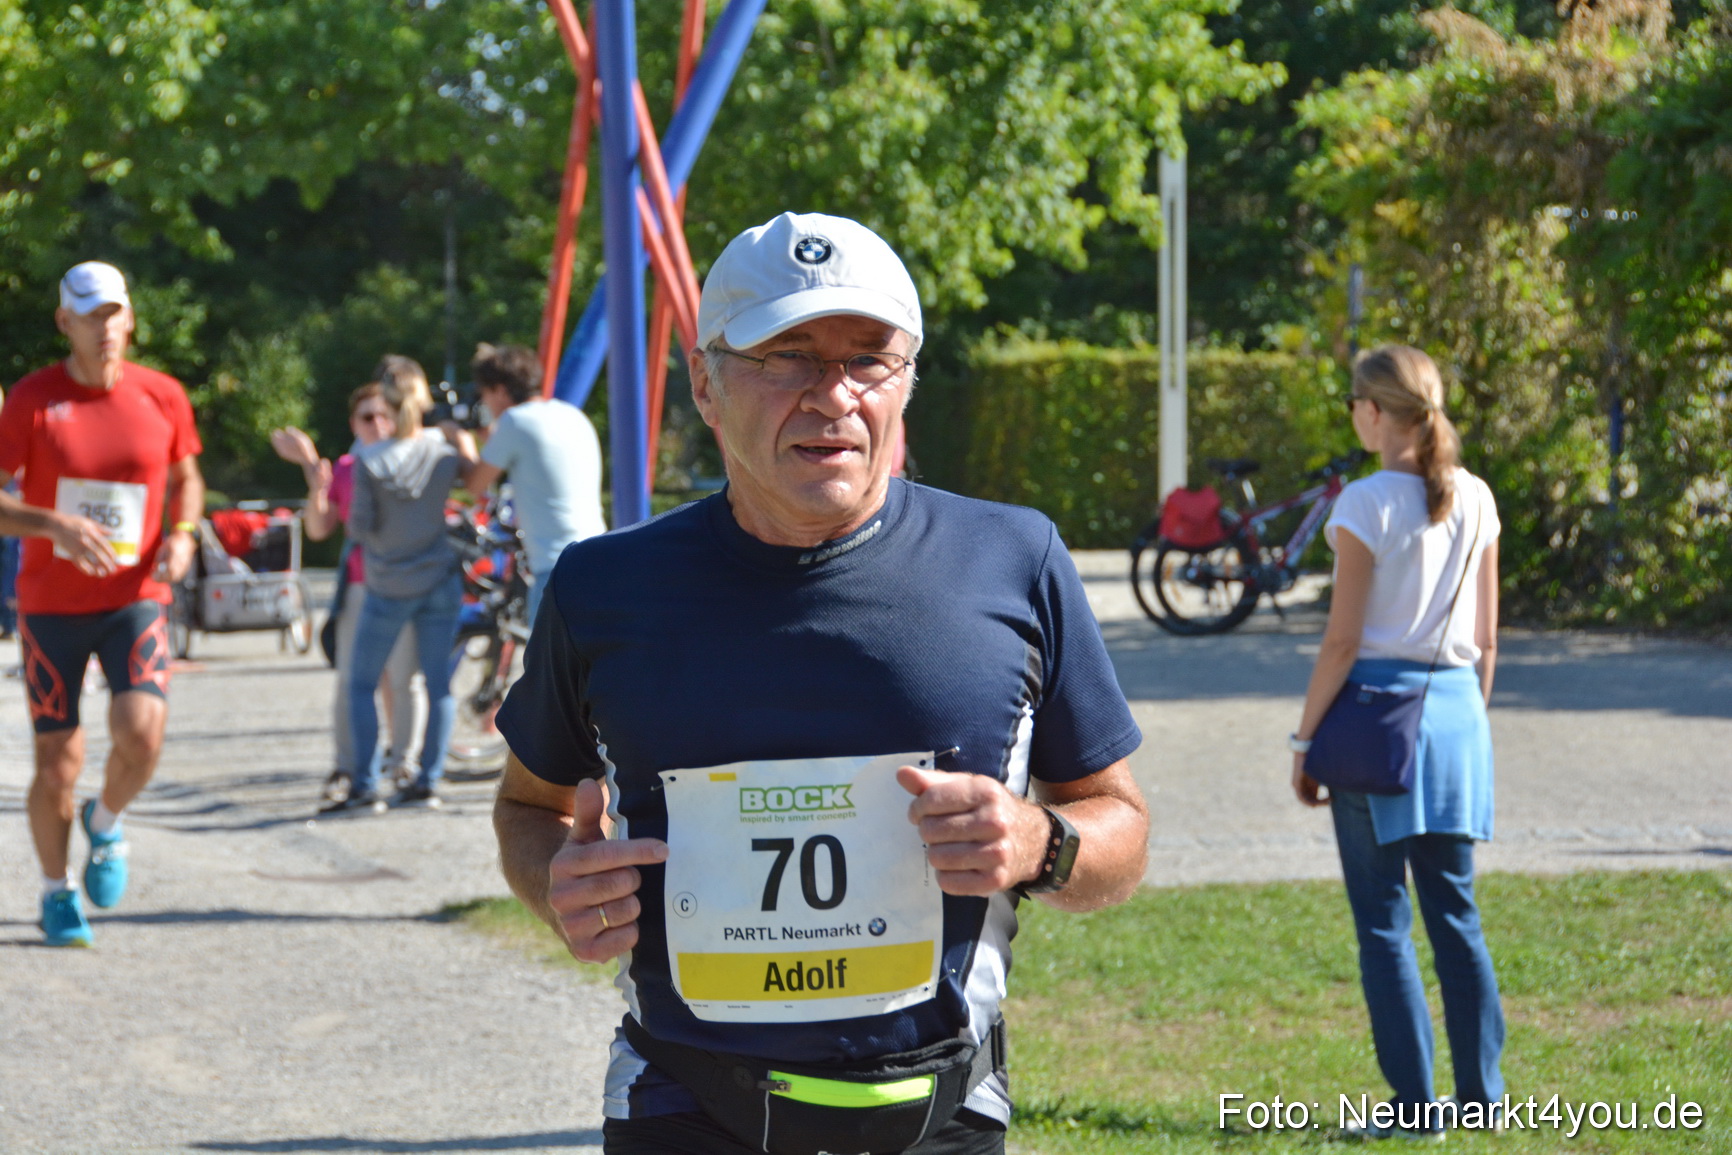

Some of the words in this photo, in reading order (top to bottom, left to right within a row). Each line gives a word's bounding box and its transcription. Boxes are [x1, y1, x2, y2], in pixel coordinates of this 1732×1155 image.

[740, 784, 855, 813] BOCK
[740, 815, 772, 824] inspired
[775, 814, 785, 823] by
[788, 813, 814, 822] smart
[817, 811, 856, 821] concepts
[751, 834, 847, 912] 70
[680, 898, 690, 912] C
[723, 927, 777, 941] PARTL
[782, 923, 861, 941] Neumarkt
[763, 957, 847, 992] Adolf
